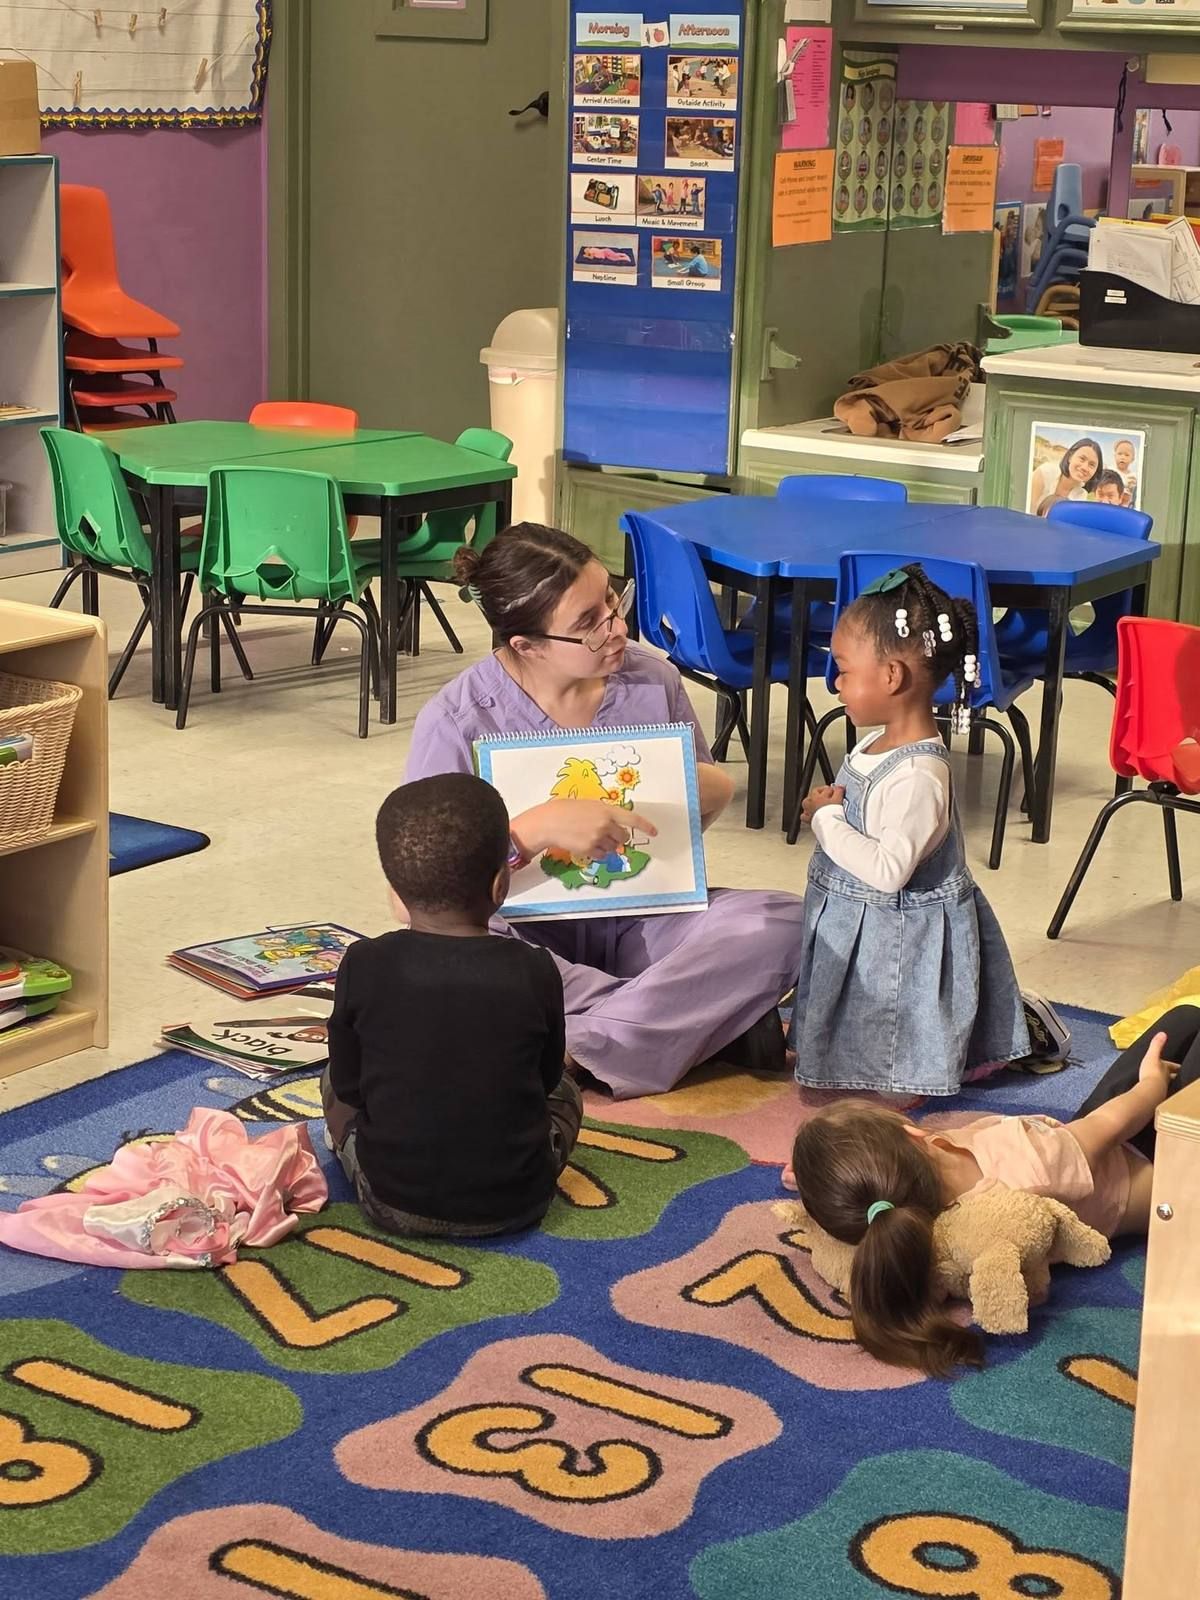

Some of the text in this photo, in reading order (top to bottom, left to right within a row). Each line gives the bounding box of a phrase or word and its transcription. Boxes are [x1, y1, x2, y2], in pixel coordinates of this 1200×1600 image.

[588, 22, 630, 38] Morning
[678, 23, 730, 38] Afternoon
[582, 96, 631, 105] Arrival Activities
[677, 99, 726, 108] Outside Activity
[586, 155, 606, 163] Center
[689, 160, 709, 168] Snack
[642, 217, 660, 226] Music
[667, 219, 698, 228] Movement
[667, 279, 706, 288] Small Group
[211, 1028, 293, 1057] black
[414, 1363, 734, 1504] 13
